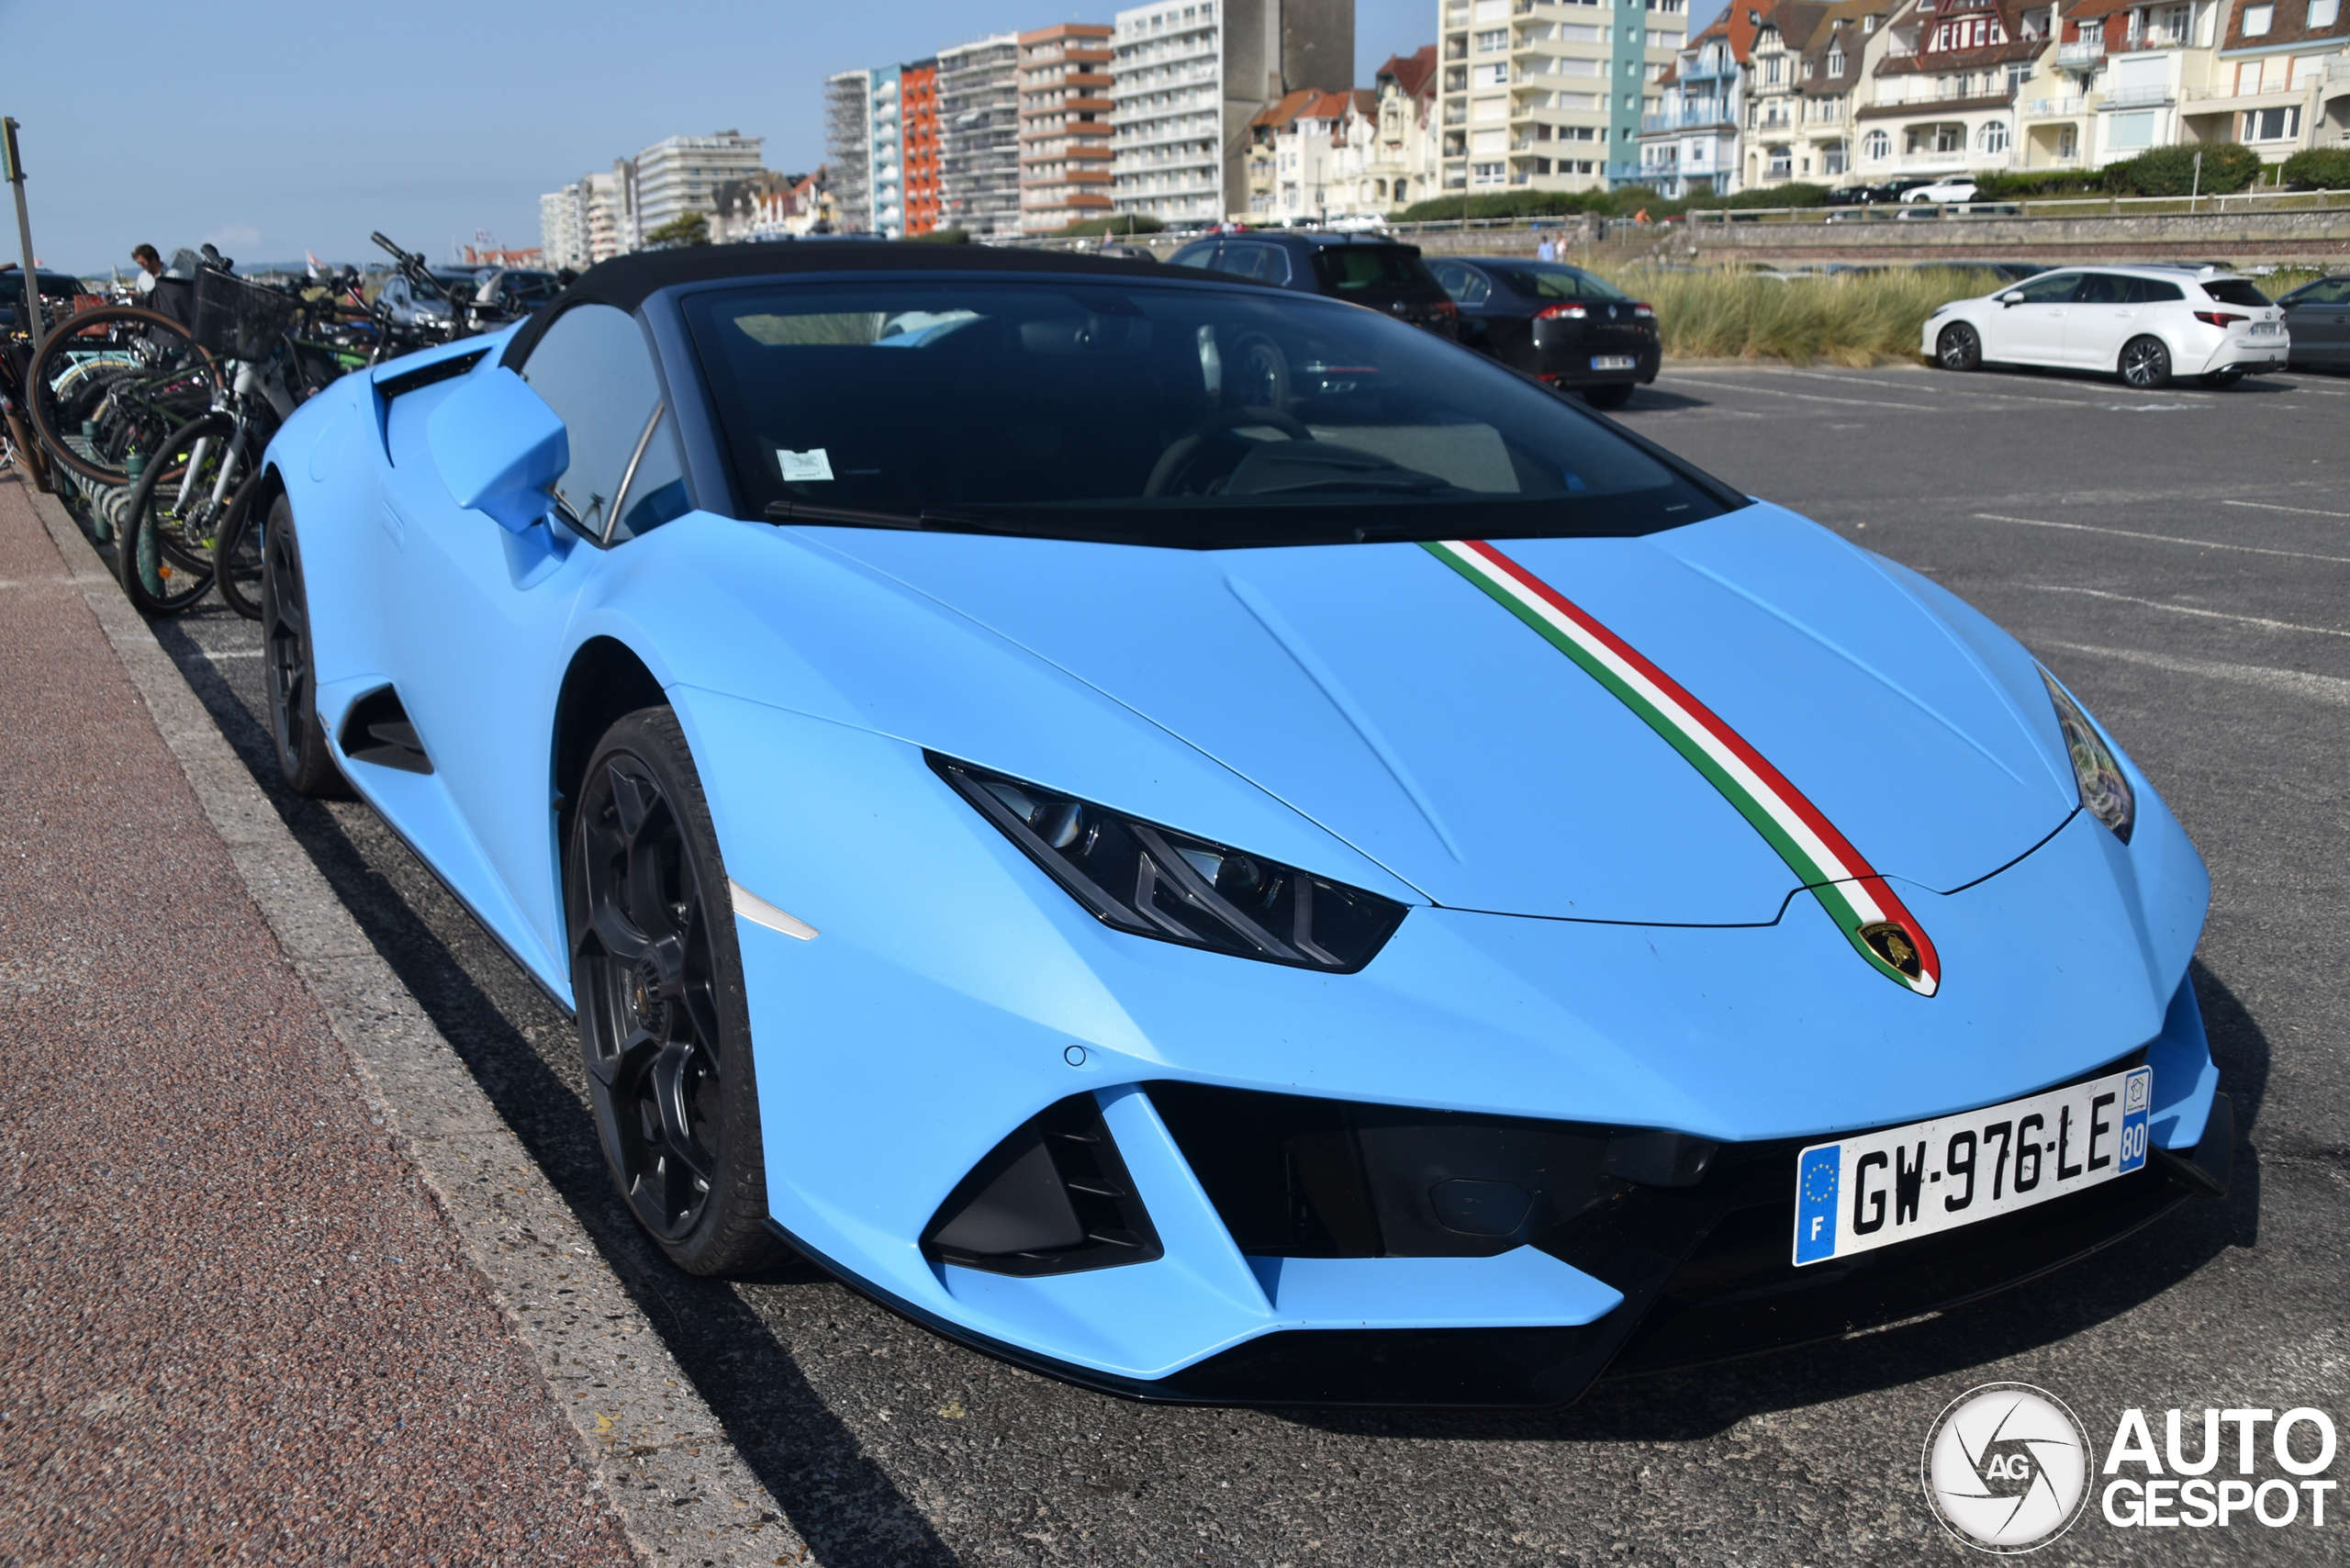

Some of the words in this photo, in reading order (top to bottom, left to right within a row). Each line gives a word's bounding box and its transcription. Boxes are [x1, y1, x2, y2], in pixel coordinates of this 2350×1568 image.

[1811, 1215, 1824, 1241] F
[1852, 1092, 2116, 1236] GW-976-LE
[2121, 1122, 2144, 1161] 80
